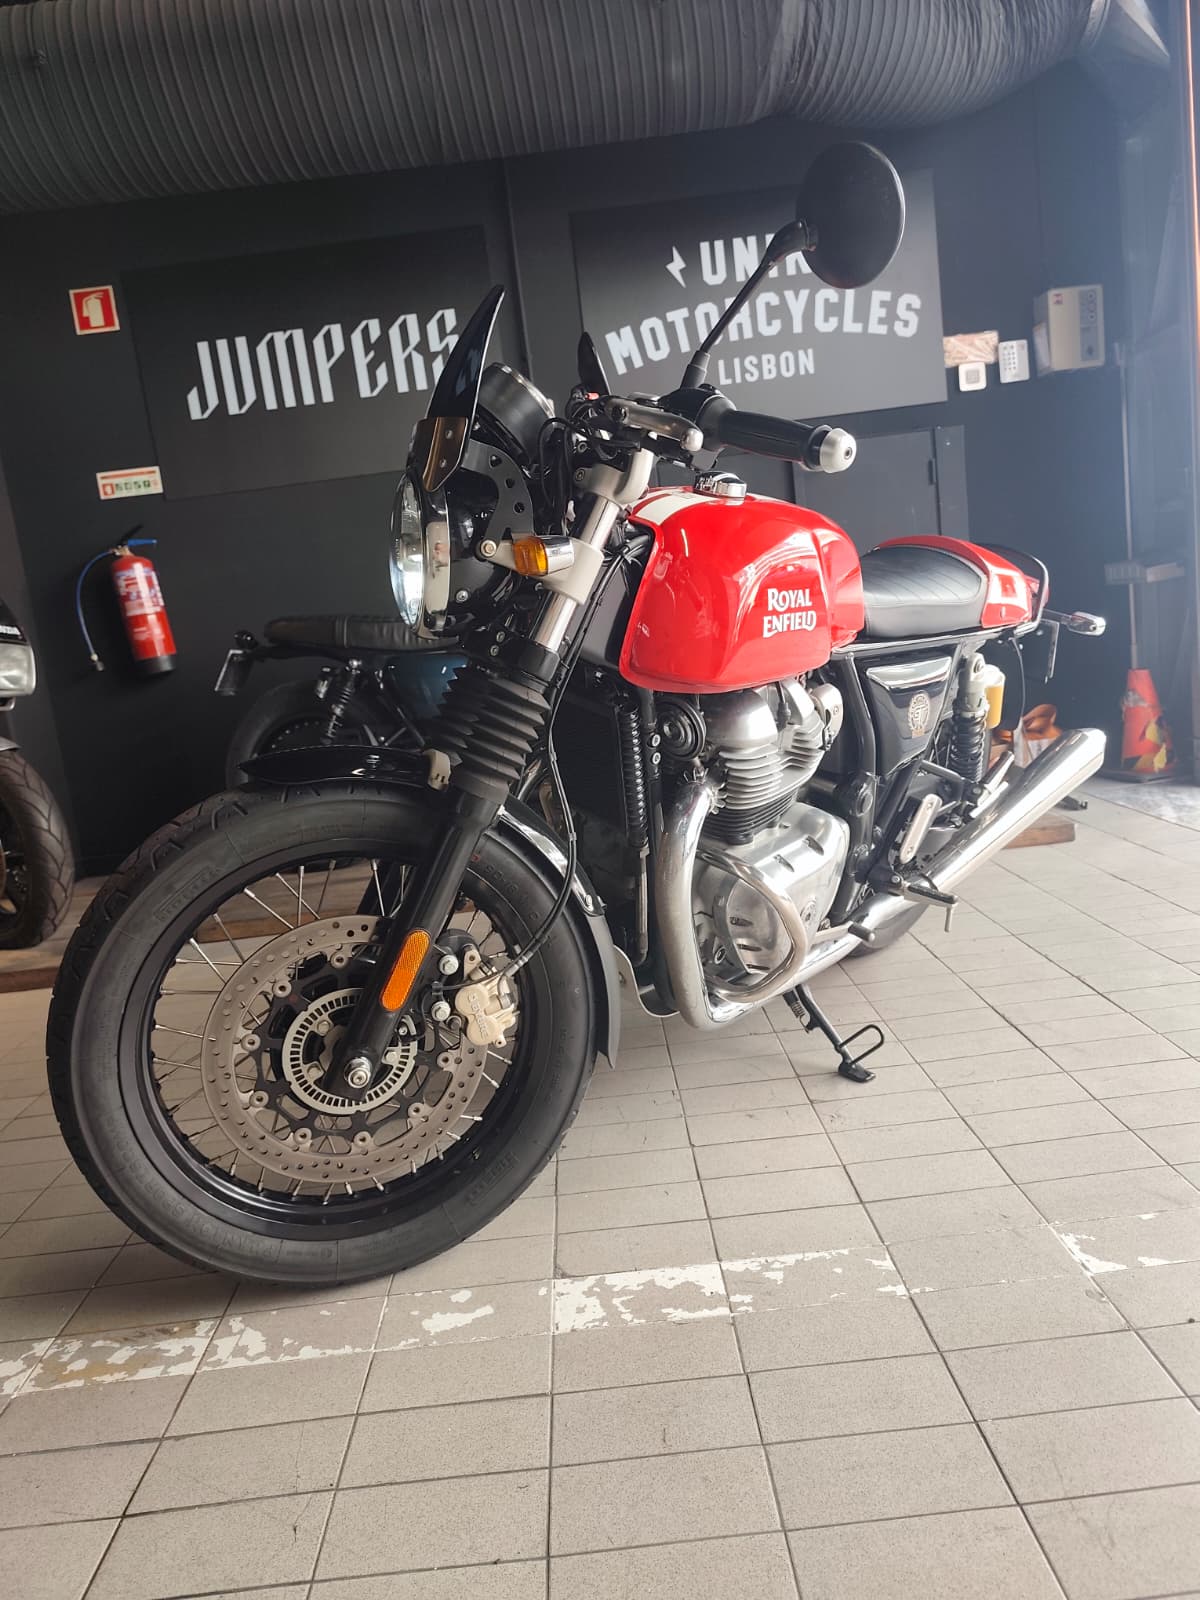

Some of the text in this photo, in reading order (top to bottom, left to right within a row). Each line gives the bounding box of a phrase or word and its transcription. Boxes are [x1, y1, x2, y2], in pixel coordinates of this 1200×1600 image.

[605, 288, 921, 375] MOTORCYCLES
[186, 308, 460, 420] JUMPERS
[718, 348, 815, 385] LISBON
[767, 587, 812, 612] ROYAL
[762, 610, 817, 638] ENFIELD
